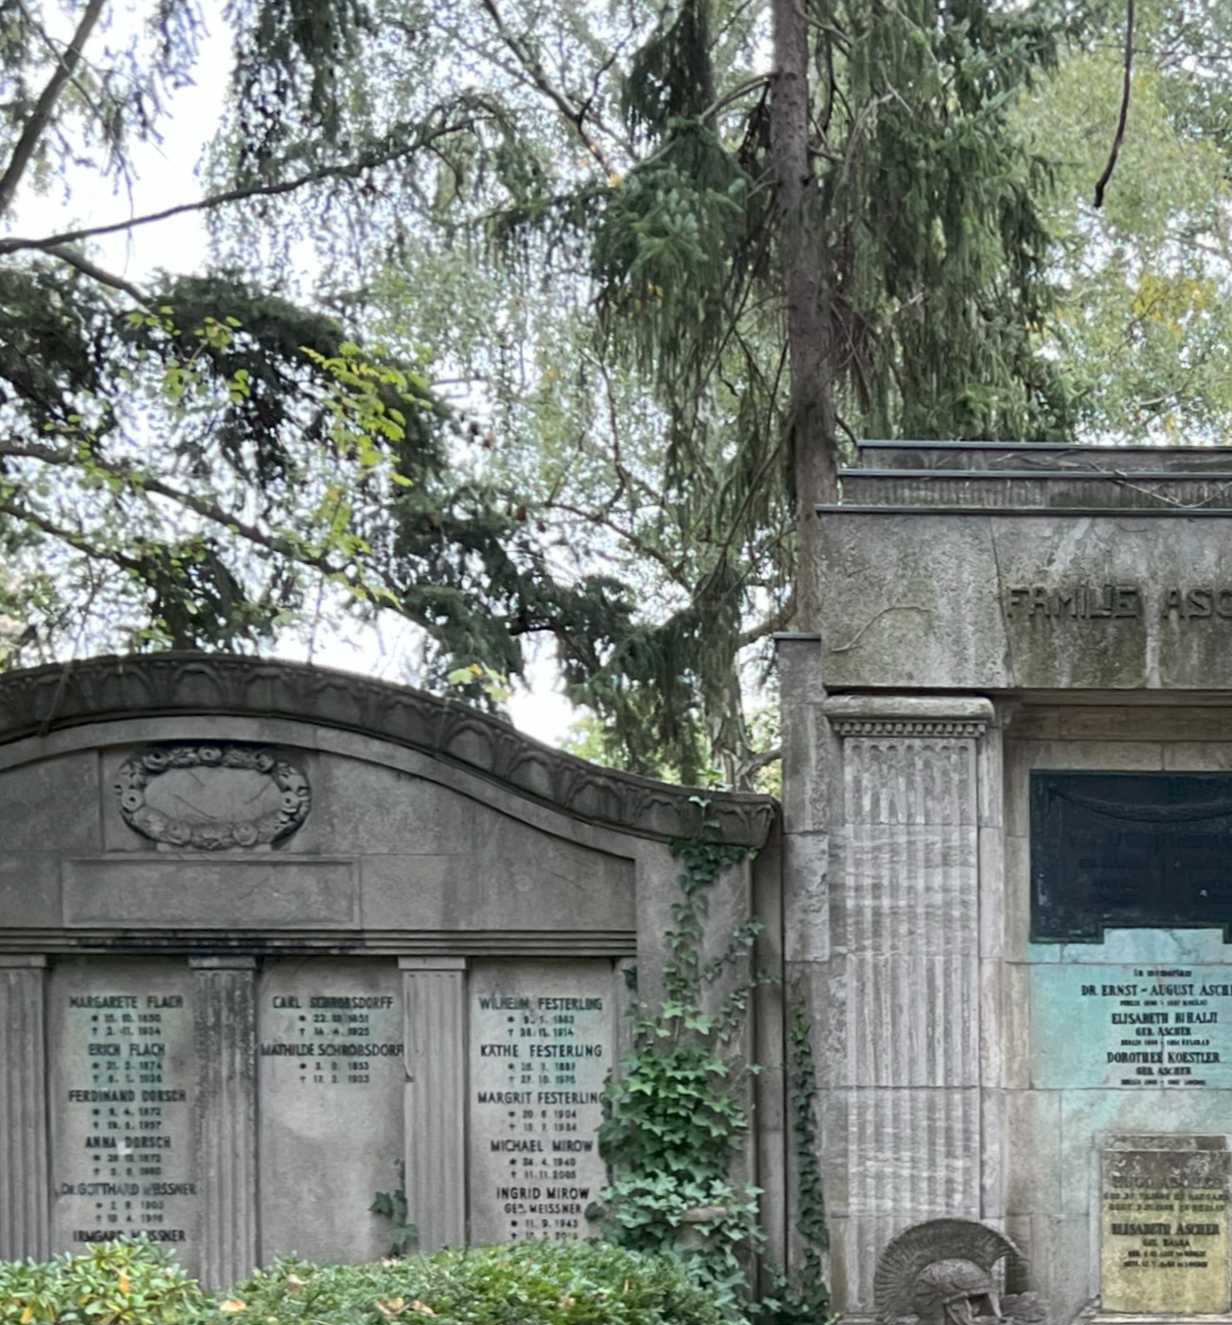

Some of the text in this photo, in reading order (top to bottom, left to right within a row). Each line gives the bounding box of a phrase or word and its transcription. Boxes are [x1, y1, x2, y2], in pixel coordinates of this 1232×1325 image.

[1005, 585, 1142, 621] FAMILIE
[1149, 984, 1195, 997] AUGUST
[272, 995, 302, 1009] CARL
[478, 997, 603, 1010] WILHELM FESTERLING
[1111, 1011, 1169, 1025] ELISABETH
[1157, 1026, 1192, 1037] ASCHER
[88, 1043, 166, 1057] ERICH FLACH
[260, 1043, 315, 1057] MATHILDE
[529, 1044, 603, 1058] FESTERLING
[1167, 1051, 1222, 1064] KOESTLER
[68, 1089, 187, 1103] FERDINAND DORSCH
[477, 1091, 533, 1105] MARGRIT
[85, 1135, 171, 1149] ANNA DORSCH
[490, 1139, 593, 1153] MICHAEL MIROW
[78, 1182, 140, 1196] GOTTHARD
[496, 1186, 591, 1200] INGRID MIROW
